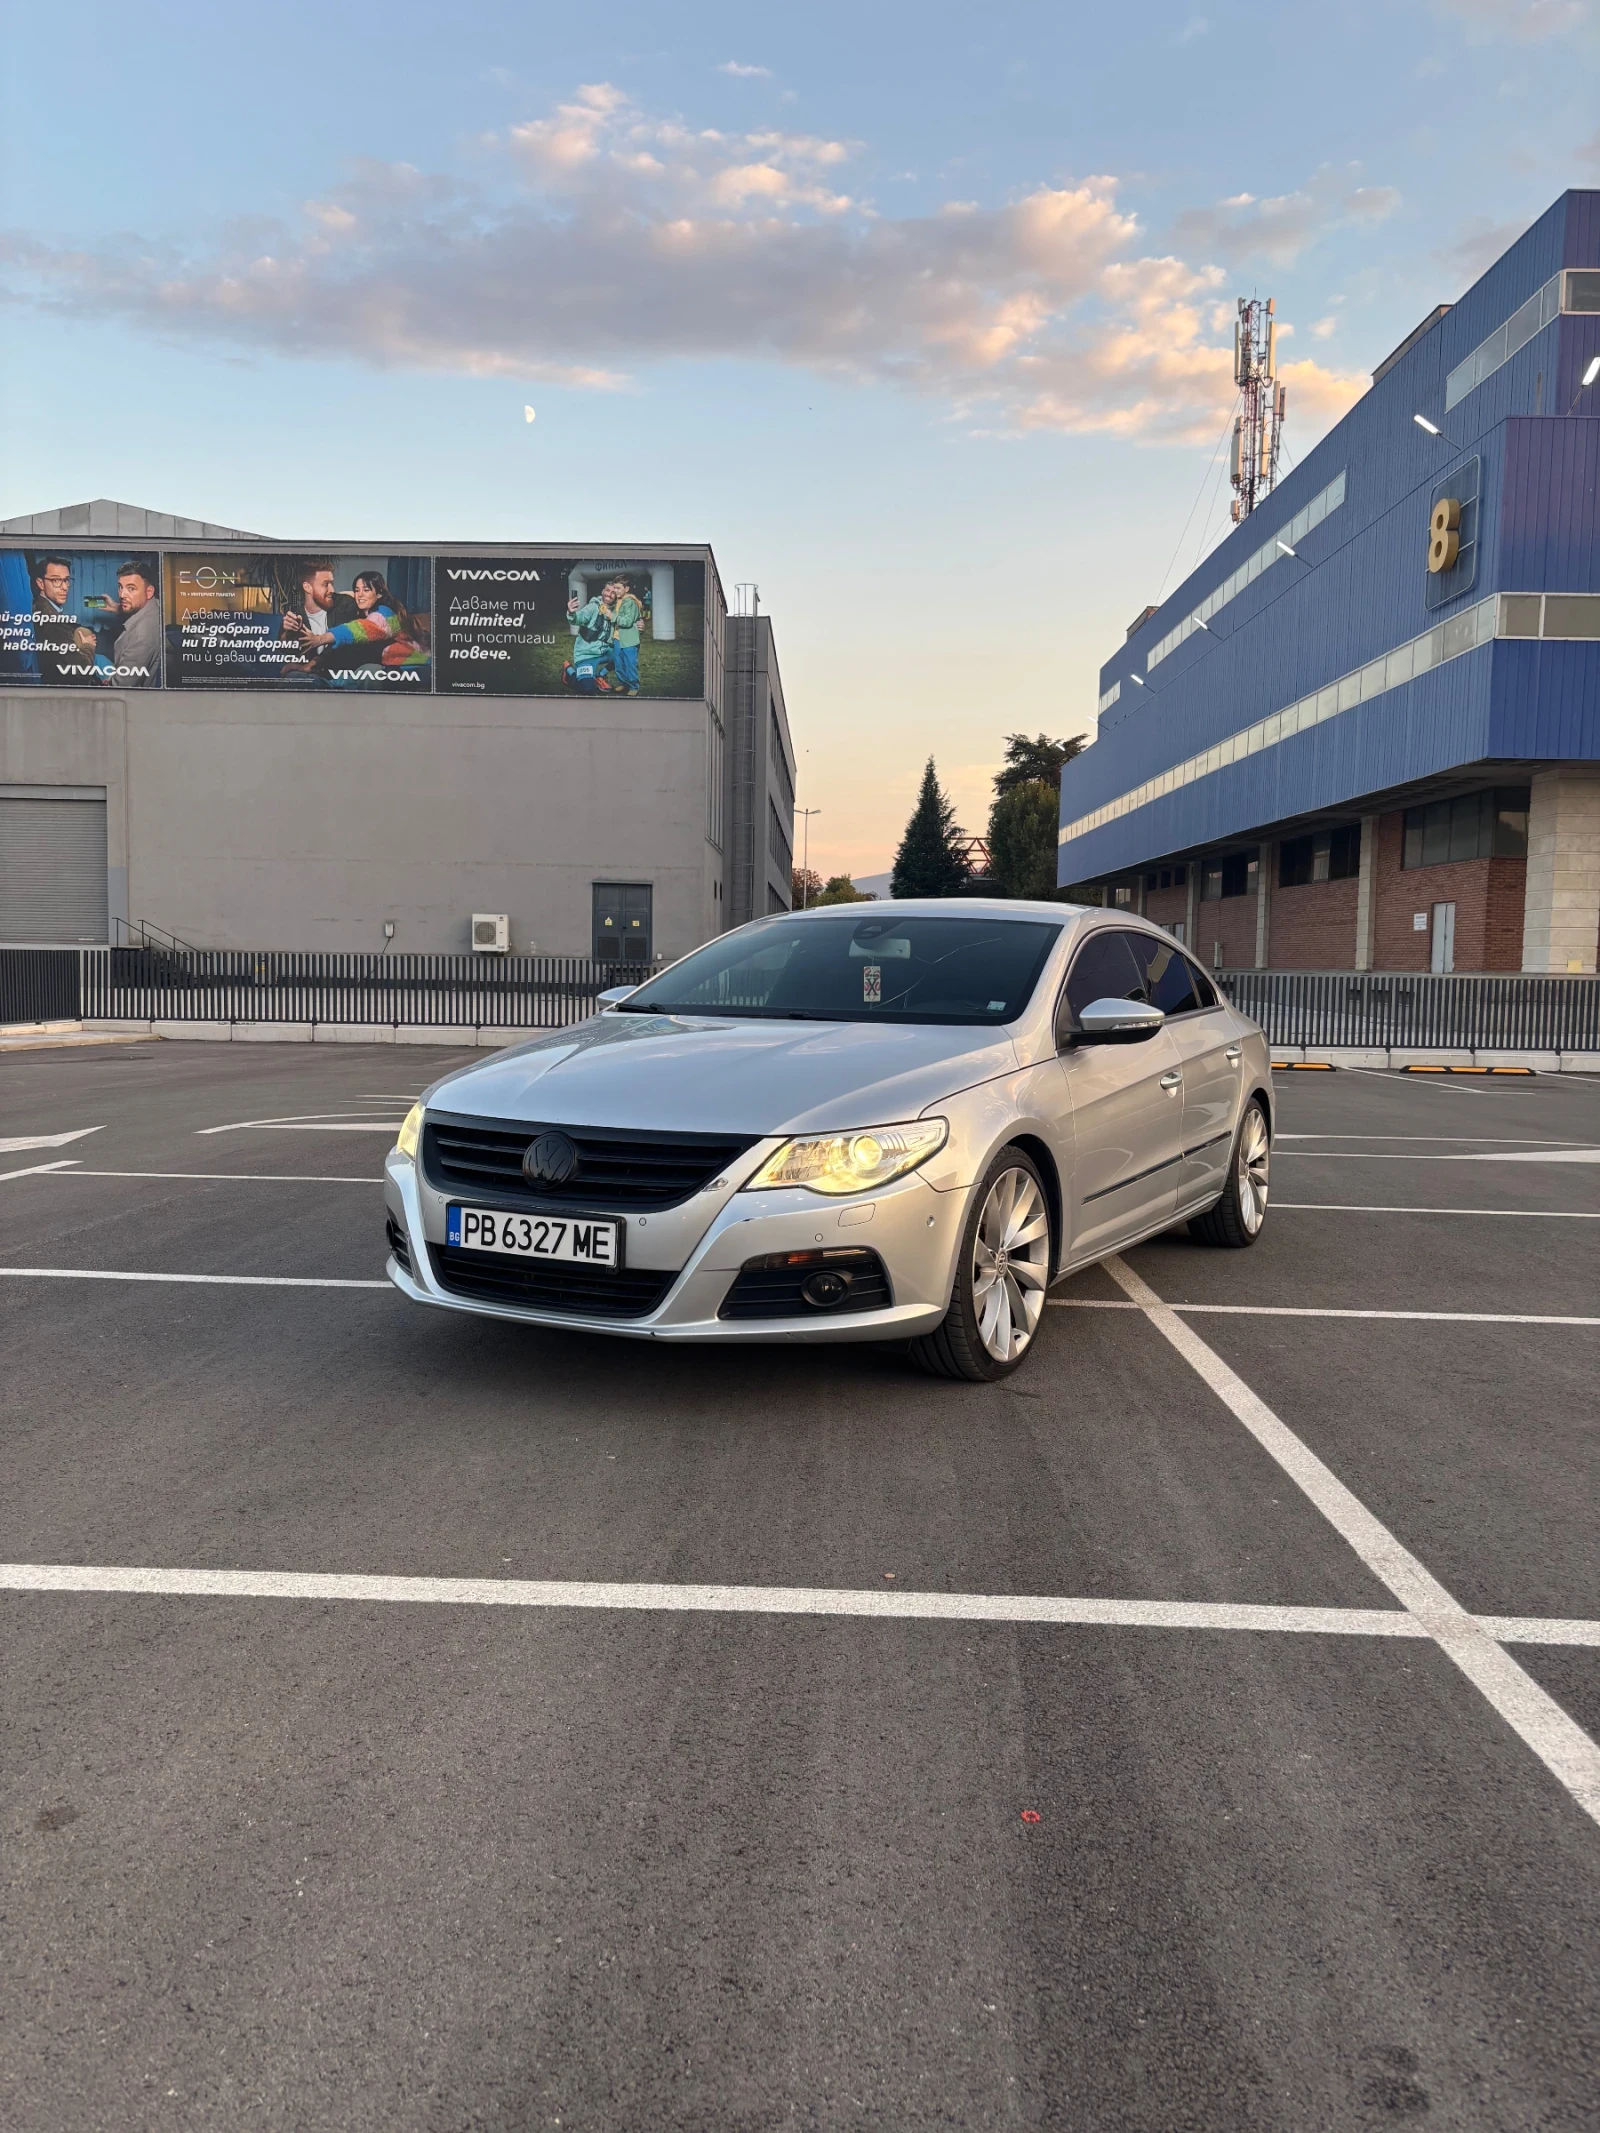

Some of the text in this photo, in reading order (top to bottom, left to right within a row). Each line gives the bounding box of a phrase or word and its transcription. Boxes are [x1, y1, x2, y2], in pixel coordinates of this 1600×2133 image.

[1428, 498, 1460, 573] 8
[594, 560, 627, 572] ФИНАЛ
[179, 566, 236, 589] EON
[446, 569, 540, 581] VIVACOM
[449, 596, 535, 611] Даваме ти
[0, 610, 77, 626] й-добрата
[181, 608, 252, 620] Даваме ти
[449, 612, 526, 629] unlimited,
[181, 622, 269, 637] най-добрата
[181, 638, 302, 653] ни ТВ платформа,
[449, 633, 555, 644] ти постигаш
[3, 639, 80, 654] навсякъде.
[449, 646, 511, 660] повече.
[182, 653, 201, 662] ти
[216, 651, 256, 666] даваш
[259, 652, 309, 663] смисъл.
[56, 664, 150, 677] VIVACOM
[328, 669, 420, 682] VIVACOM
[451, 681, 485, 689] vivacom.bg
[449, 1231, 460, 1242] BG
[464, 1212, 610, 1260] PB 6327 ME
